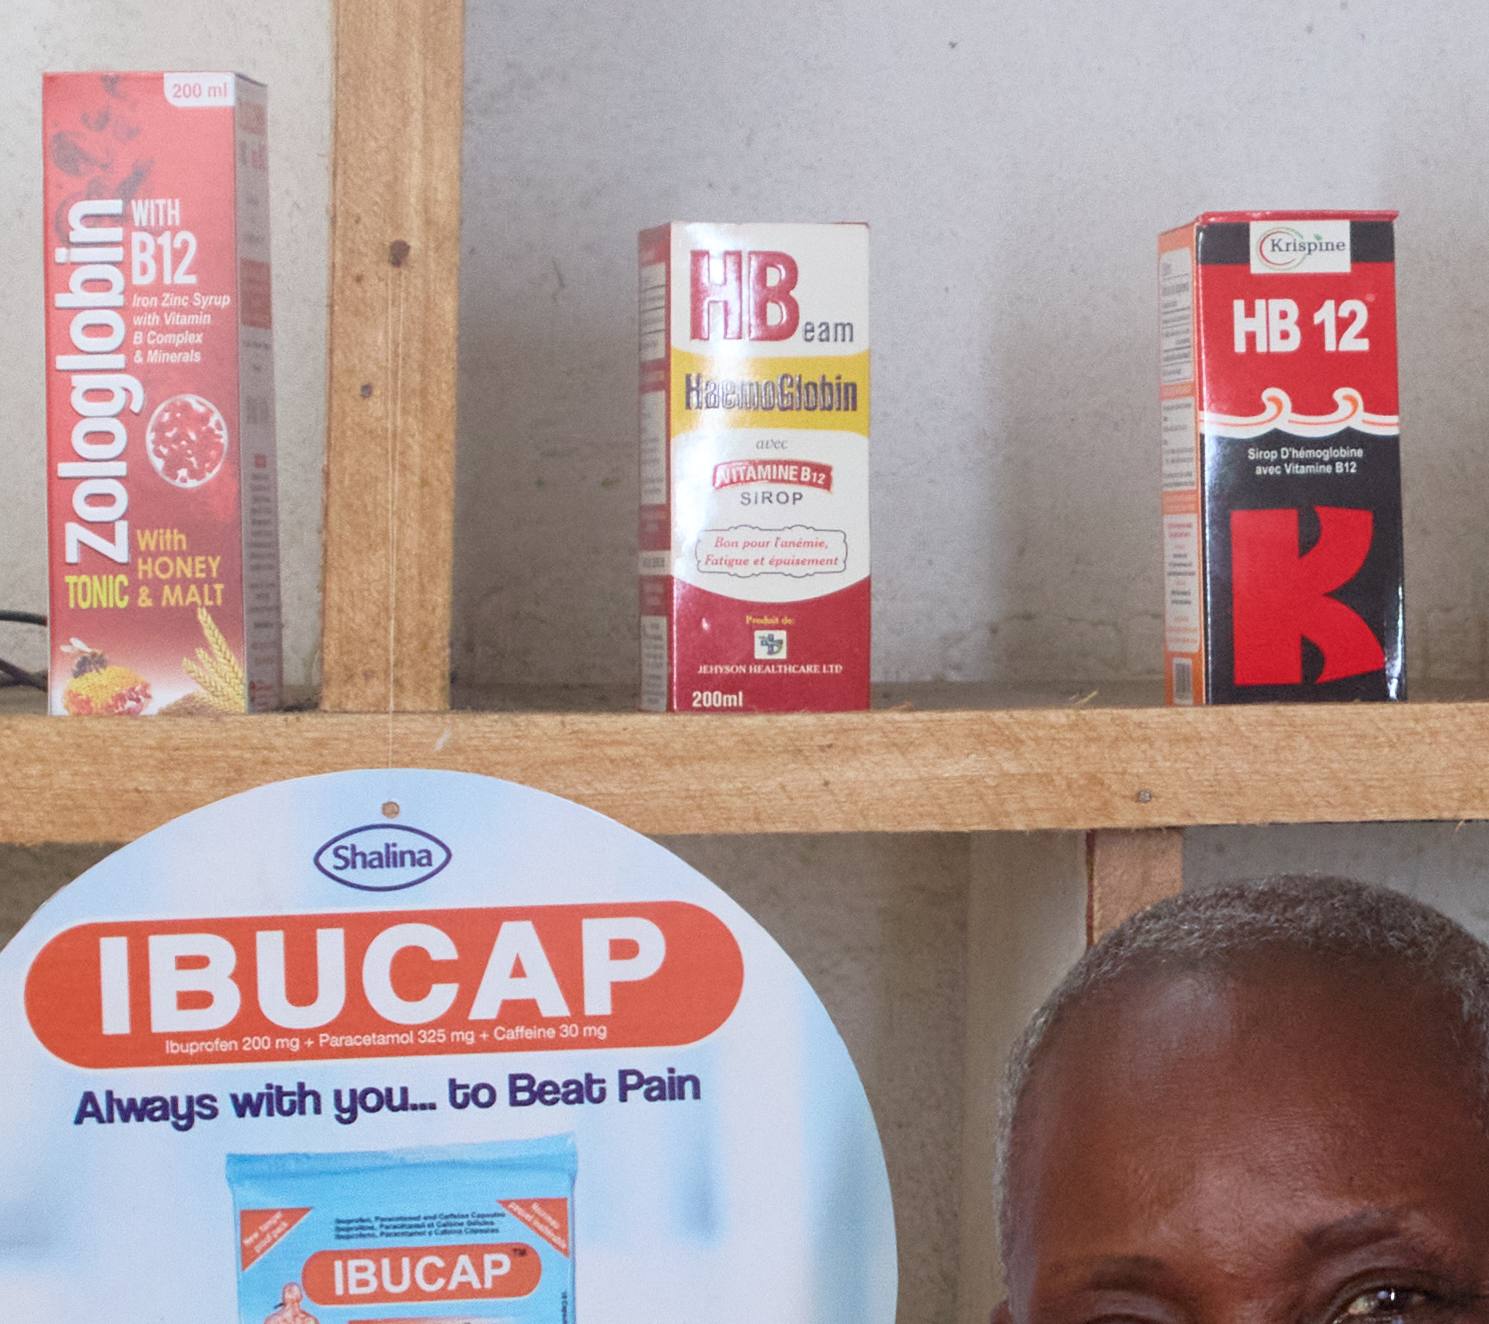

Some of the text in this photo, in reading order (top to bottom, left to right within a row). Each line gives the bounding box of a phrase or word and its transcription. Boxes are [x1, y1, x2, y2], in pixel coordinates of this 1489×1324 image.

[132, 200, 180, 226] WITH
[131, 232, 196, 285] B12
[1271, 237, 1345, 256] Krispine
[133, 311, 211, 325] with Vitamin
[1233, 299, 1369, 353] HB 12
[55, 199, 144, 565] Zologlobin
[685, 373, 858, 412] HaemoGlobin
[756, 438, 787, 449] avec
[1248, 447, 1363, 462] Sirop D'hémoglobine
[1255, 462, 1357, 475] avec Vitamine B12
[741, 492, 803, 506] SIROP
[137, 528, 187, 552] With
[137, 554, 220, 579] HONEY
[66, 574, 129, 609] TONIC
[692, 691, 743, 708] 200ml
[332, 842, 434, 872] Shalina
[99, 917, 666, 1036] IBUCAP
[73, 1066, 701, 1132] Always with you... to Beat Pain
[334, 1253, 511, 1296] IBUCAP
